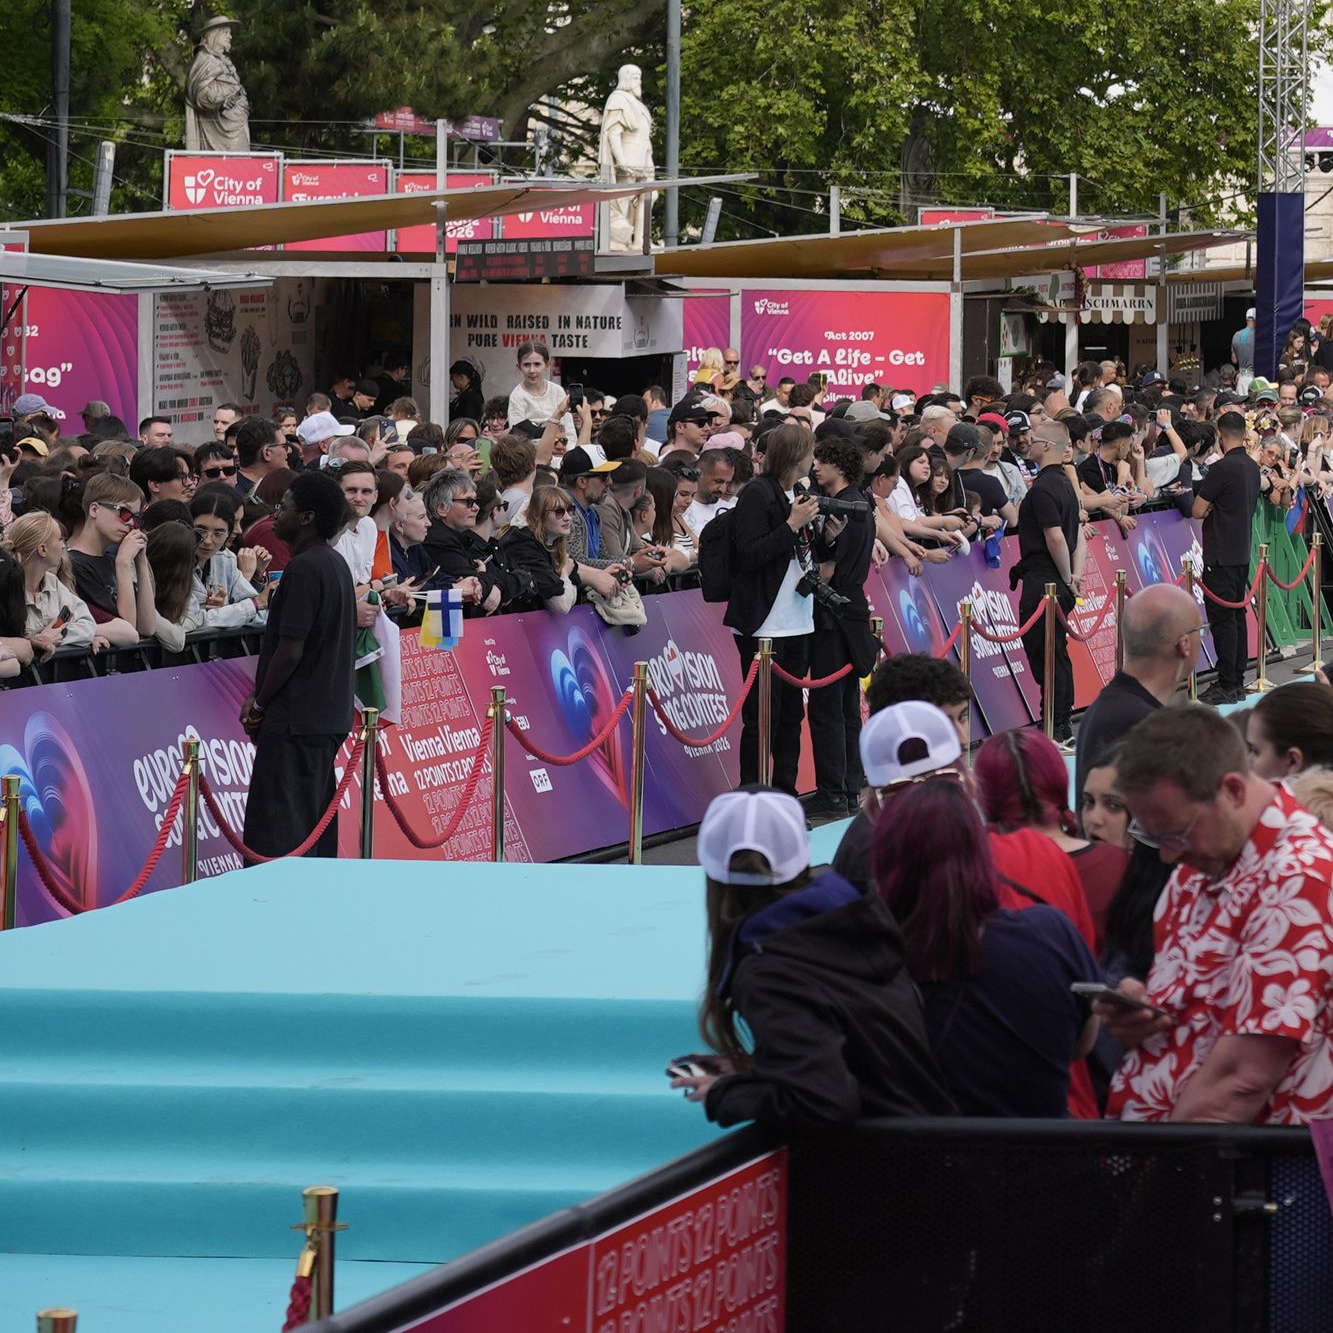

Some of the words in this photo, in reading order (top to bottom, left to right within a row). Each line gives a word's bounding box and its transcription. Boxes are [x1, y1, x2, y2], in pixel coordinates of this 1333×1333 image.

[213, 176, 244, 194] City
[245, 177, 263, 191] of
[213, 190, 264, 206] Vienna
[539, 211, 583, 225] Vienna
[767, 300, 780, 309] City
[780, 301, 789, 309] of
[467, 315, 498, 329] WILD
[506, 315, 550, 330] RAISED
[558, 315, 571, 329] IN
[575, 315, 622, 330] NATURE
[467, 333, 498, 348] PURE
[824, 331, 847, 341] Act
[848, 331, 875, 341] 2007
[816, 348, 832, 365] A
[834, 347, 871, 365] Life
[889, 348, 926, 365] Get
[681, 689, 731, 731] CONTEST
[399, 731, 444, 763] Vienna
[443, 726, 481, 755] Vienna
[713, 737, 731, 752] 2026
[413, 772, 424, 791] 12
[422, 763, 454, 788] POINTS
[452, 761, 463, 781] 12
[533, 773, 549, 788] ORF
[198, 852, 244, 877] VIENNA
[618, 1211, 693, 1304] POINTS
[713, 1167, 781, 1255] POINTS
[712, 1229, 780, 1320] POINTS
